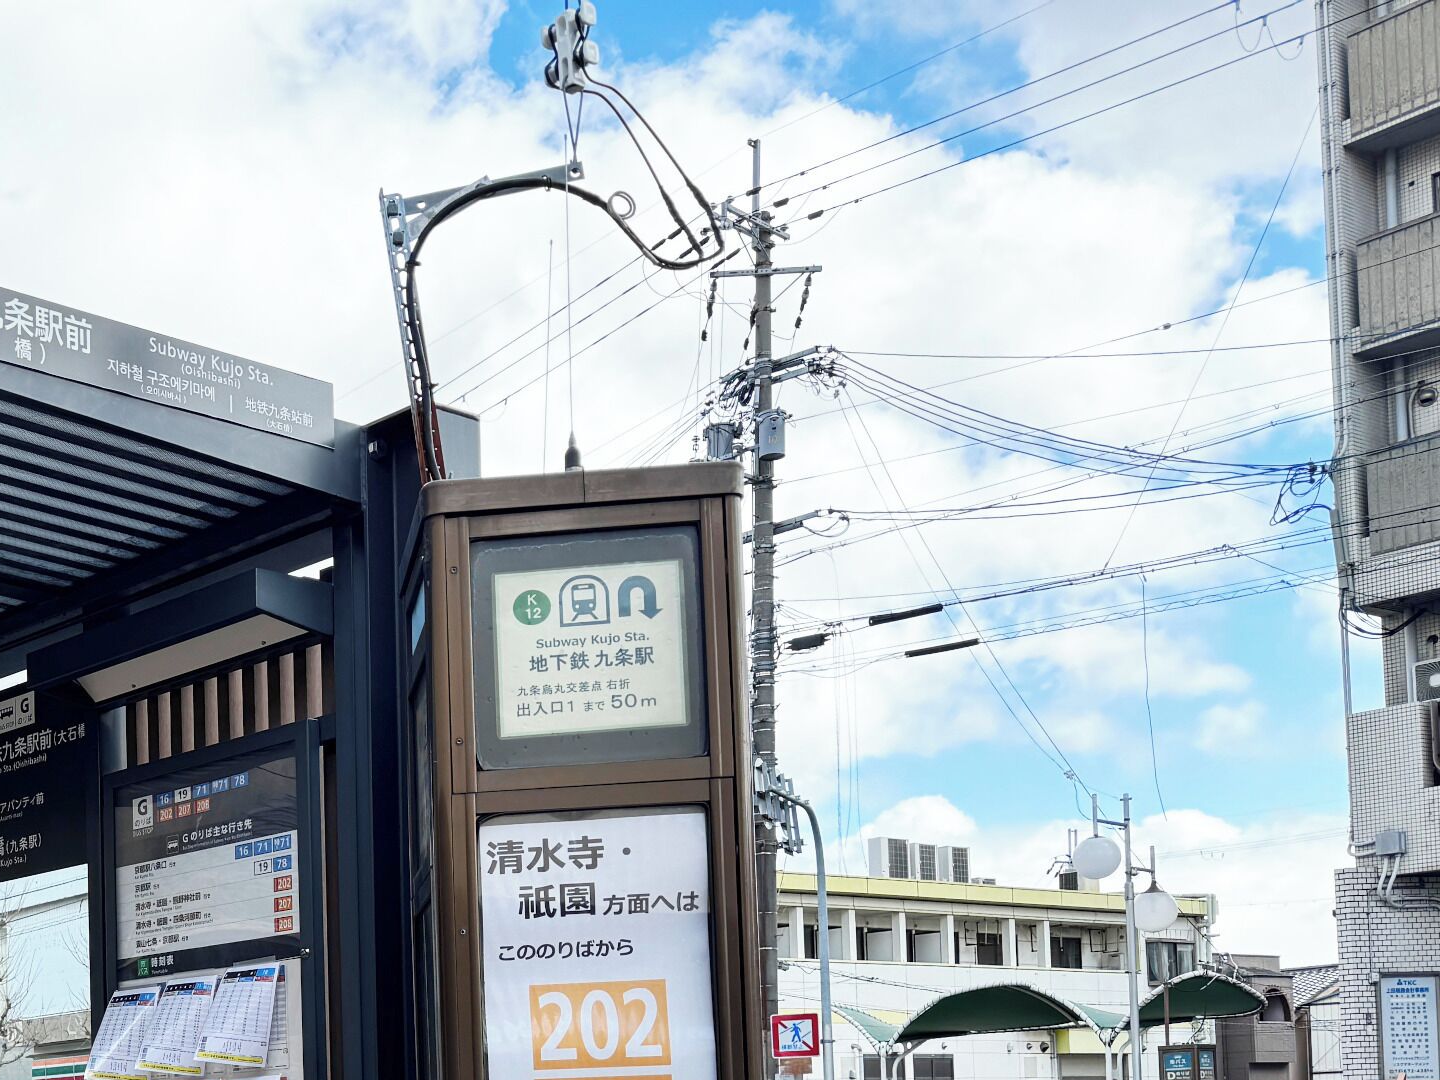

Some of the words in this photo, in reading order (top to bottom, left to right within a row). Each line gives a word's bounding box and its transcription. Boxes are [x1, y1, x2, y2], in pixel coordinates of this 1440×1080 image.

[149, 337, 206, 370] Subway
[211, 355, 244, 380] Kujo
[248, 365, 274, 386] Sta.
[107, 358, 143, 383] 지하철
[147, 369, 216, 402] 구조에키마에
[181, 363, 242, 390] (Oishibashi)
[527, 594, 537, 605] K
[525, 607, 541, 619] 12
[536, 635, 587, 649] Subway
[591, 632, 620, 646] Kujo
[624, 632, 650, 642] Sta.
[529, 651, 590, 673] 地下鉄
[594, 646, 655, 668] 九条駅
[606, 678, 630, 691] 右折
[20, 698, 30, 714] G
[516, 700, 575, 718] 出入口1
[583, 700, 605, 712] まで
[159, 794, 169, 805] 16
[177, 789, 188, 800] 19
[196, 785, 207, 796] 71
[234, 774, 245, 786] 78
[137, 798, 148, 816] G
[159, 807, 173, 821] 202
[178, 804, 191, 816] 207
[196, 799, 210, 812] 208
[134, 816, 152, 827] のりば
[238, 846, 249, 856] 16
[256, 841, 268, 852] 71
[258, 861, 269, 872] 19
[277, 858, 288, 869] 78
[277, 877, 292, 889] 202
[278, 898, 291, 909] 207
[279, 918, 292, 929] 208
[498, 939, 634, 962] こののりばから
[538, 987, 663, 1061] 202
[1166, 1071, 1176, 1080] D
